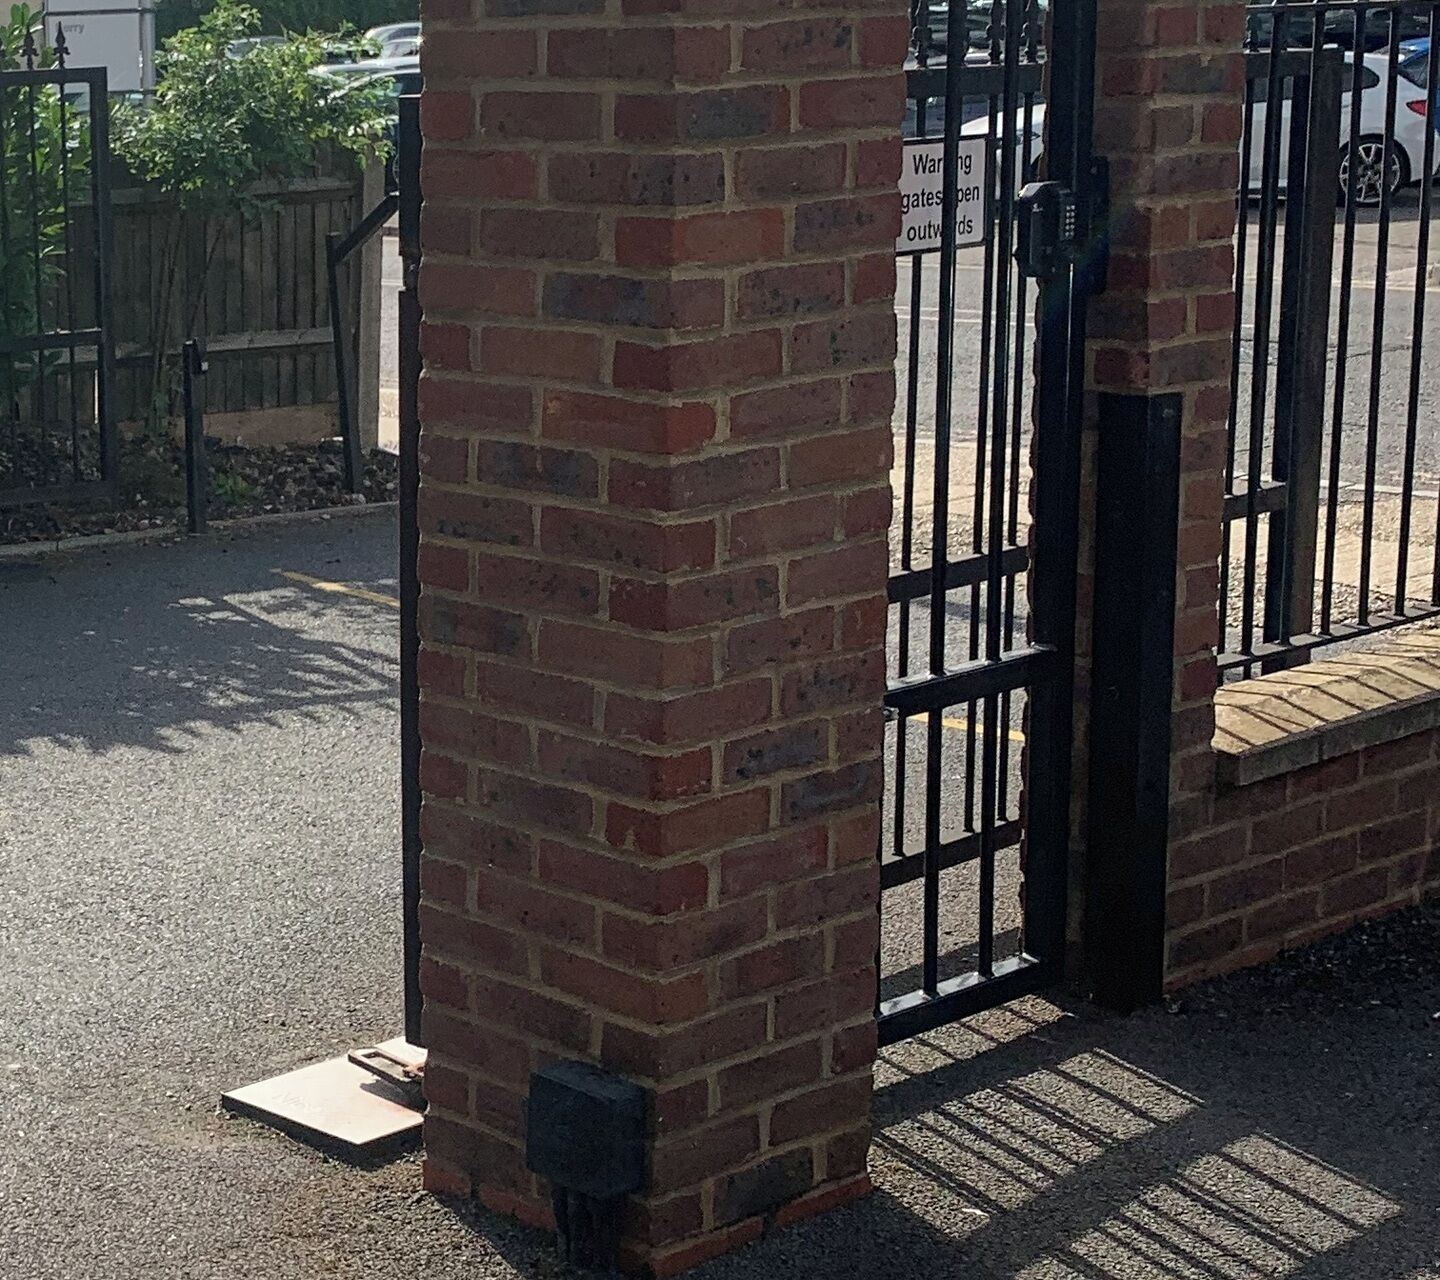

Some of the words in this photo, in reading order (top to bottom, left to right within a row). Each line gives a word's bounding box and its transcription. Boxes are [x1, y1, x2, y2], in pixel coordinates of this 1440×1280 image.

[913, 153, 972, 175] Warng
[902, 188, 943, 214] gates
[955, 186, 980, 206] pen
[907, 214, 973, 242] outwds
